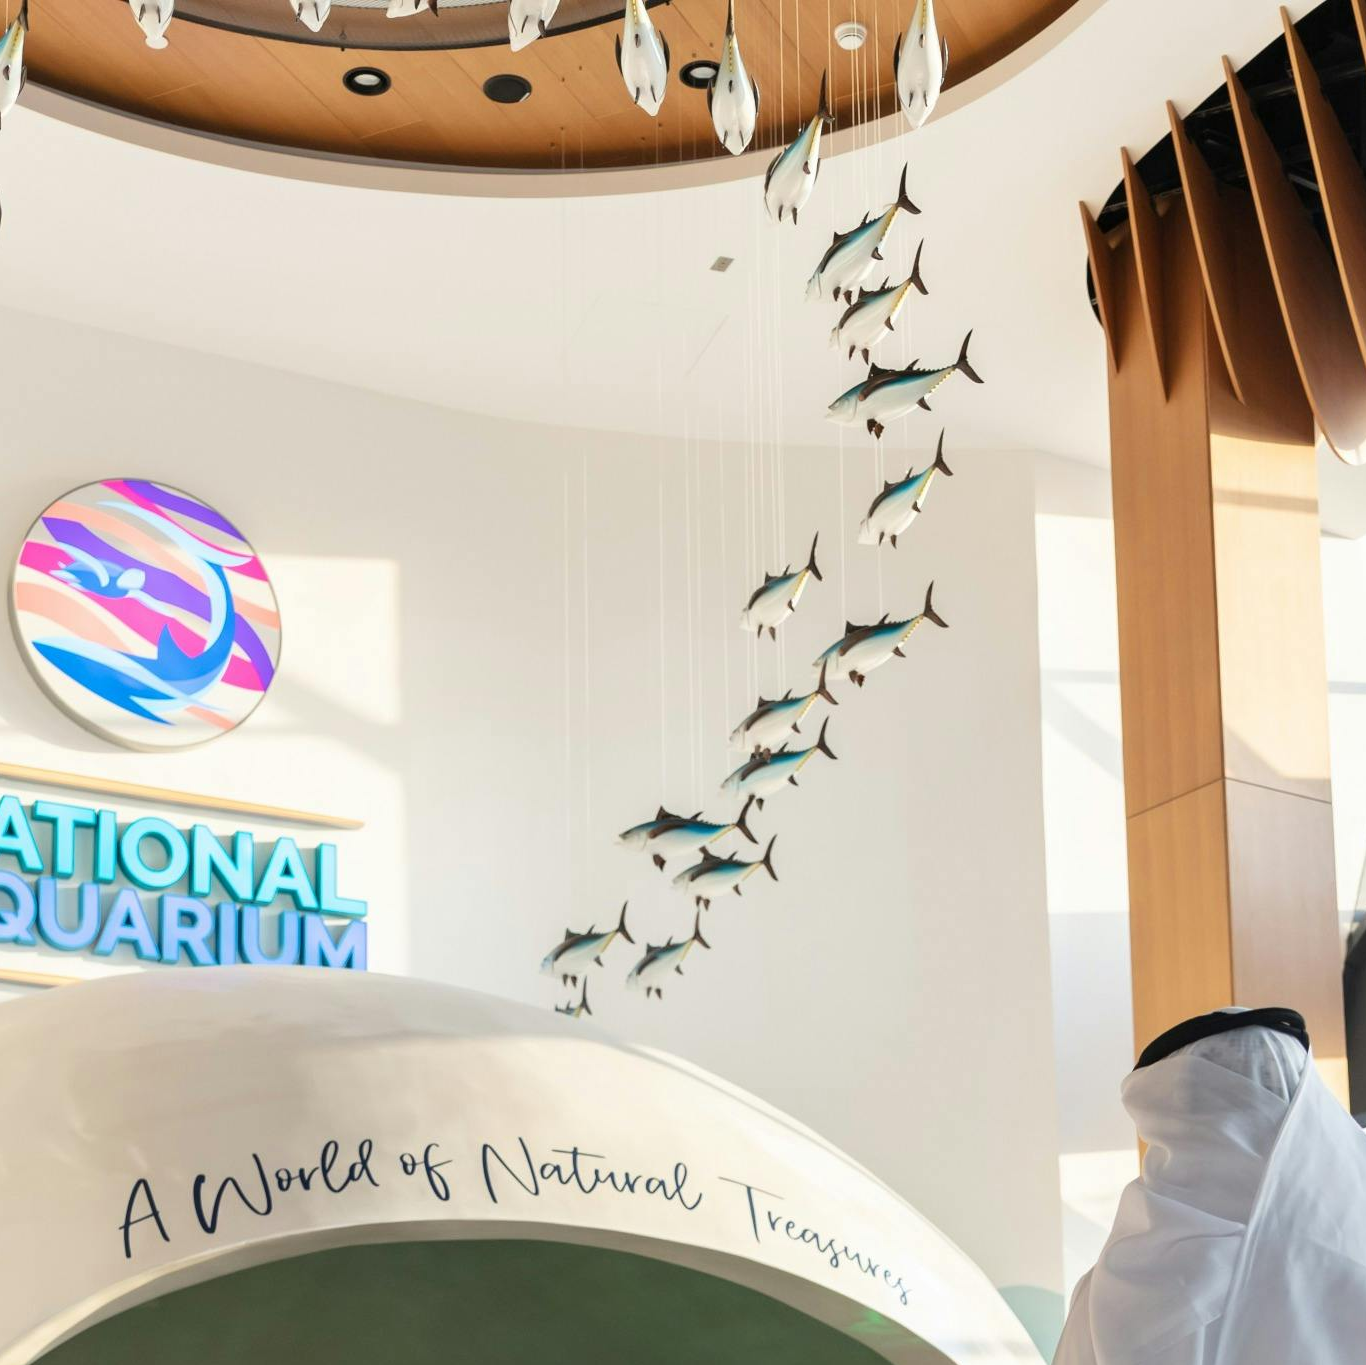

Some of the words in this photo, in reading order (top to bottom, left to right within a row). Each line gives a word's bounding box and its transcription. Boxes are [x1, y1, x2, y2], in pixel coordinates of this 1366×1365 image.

[117, 1177, 171, 1259] A
[192, 1138, 380, 1235] World
[399, 1142, 453, 1203] of
[481, 1136, 703, 1212] Natural
[717, 1176, 913, 1307] Treasures
